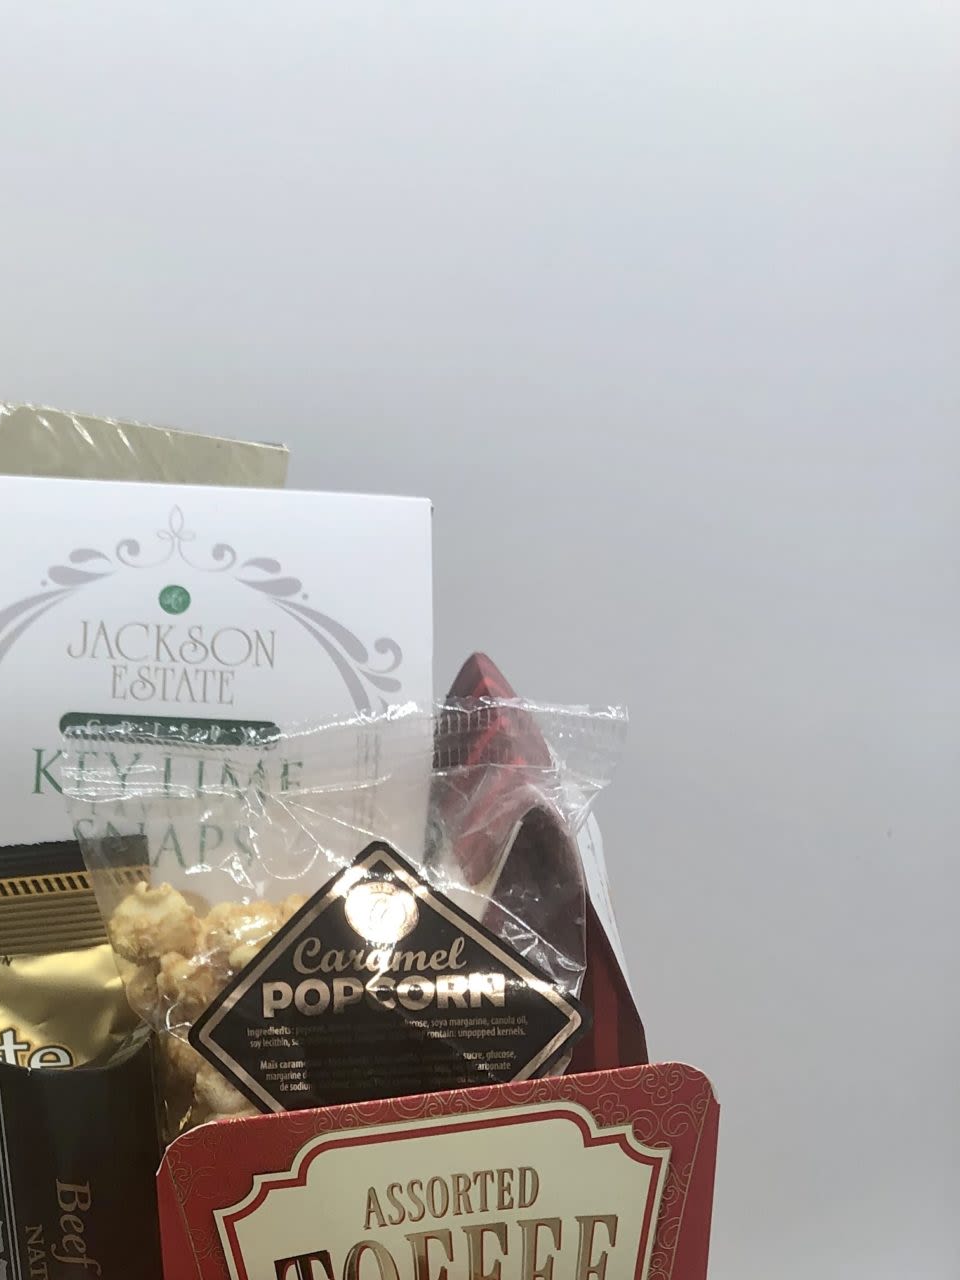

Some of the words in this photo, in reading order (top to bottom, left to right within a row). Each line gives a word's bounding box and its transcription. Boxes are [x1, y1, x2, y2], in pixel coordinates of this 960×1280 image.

[66, 618, 277, 670] JACKSON
[111, 663, 236, 707] ESTATE
[292, 936, 467, 975] Caramel
[262, 972, 506, 1019] POPCORN
[362, 1165, 541, 1231] ASSORTED
[50, 1177, 102, 1277] Beef
